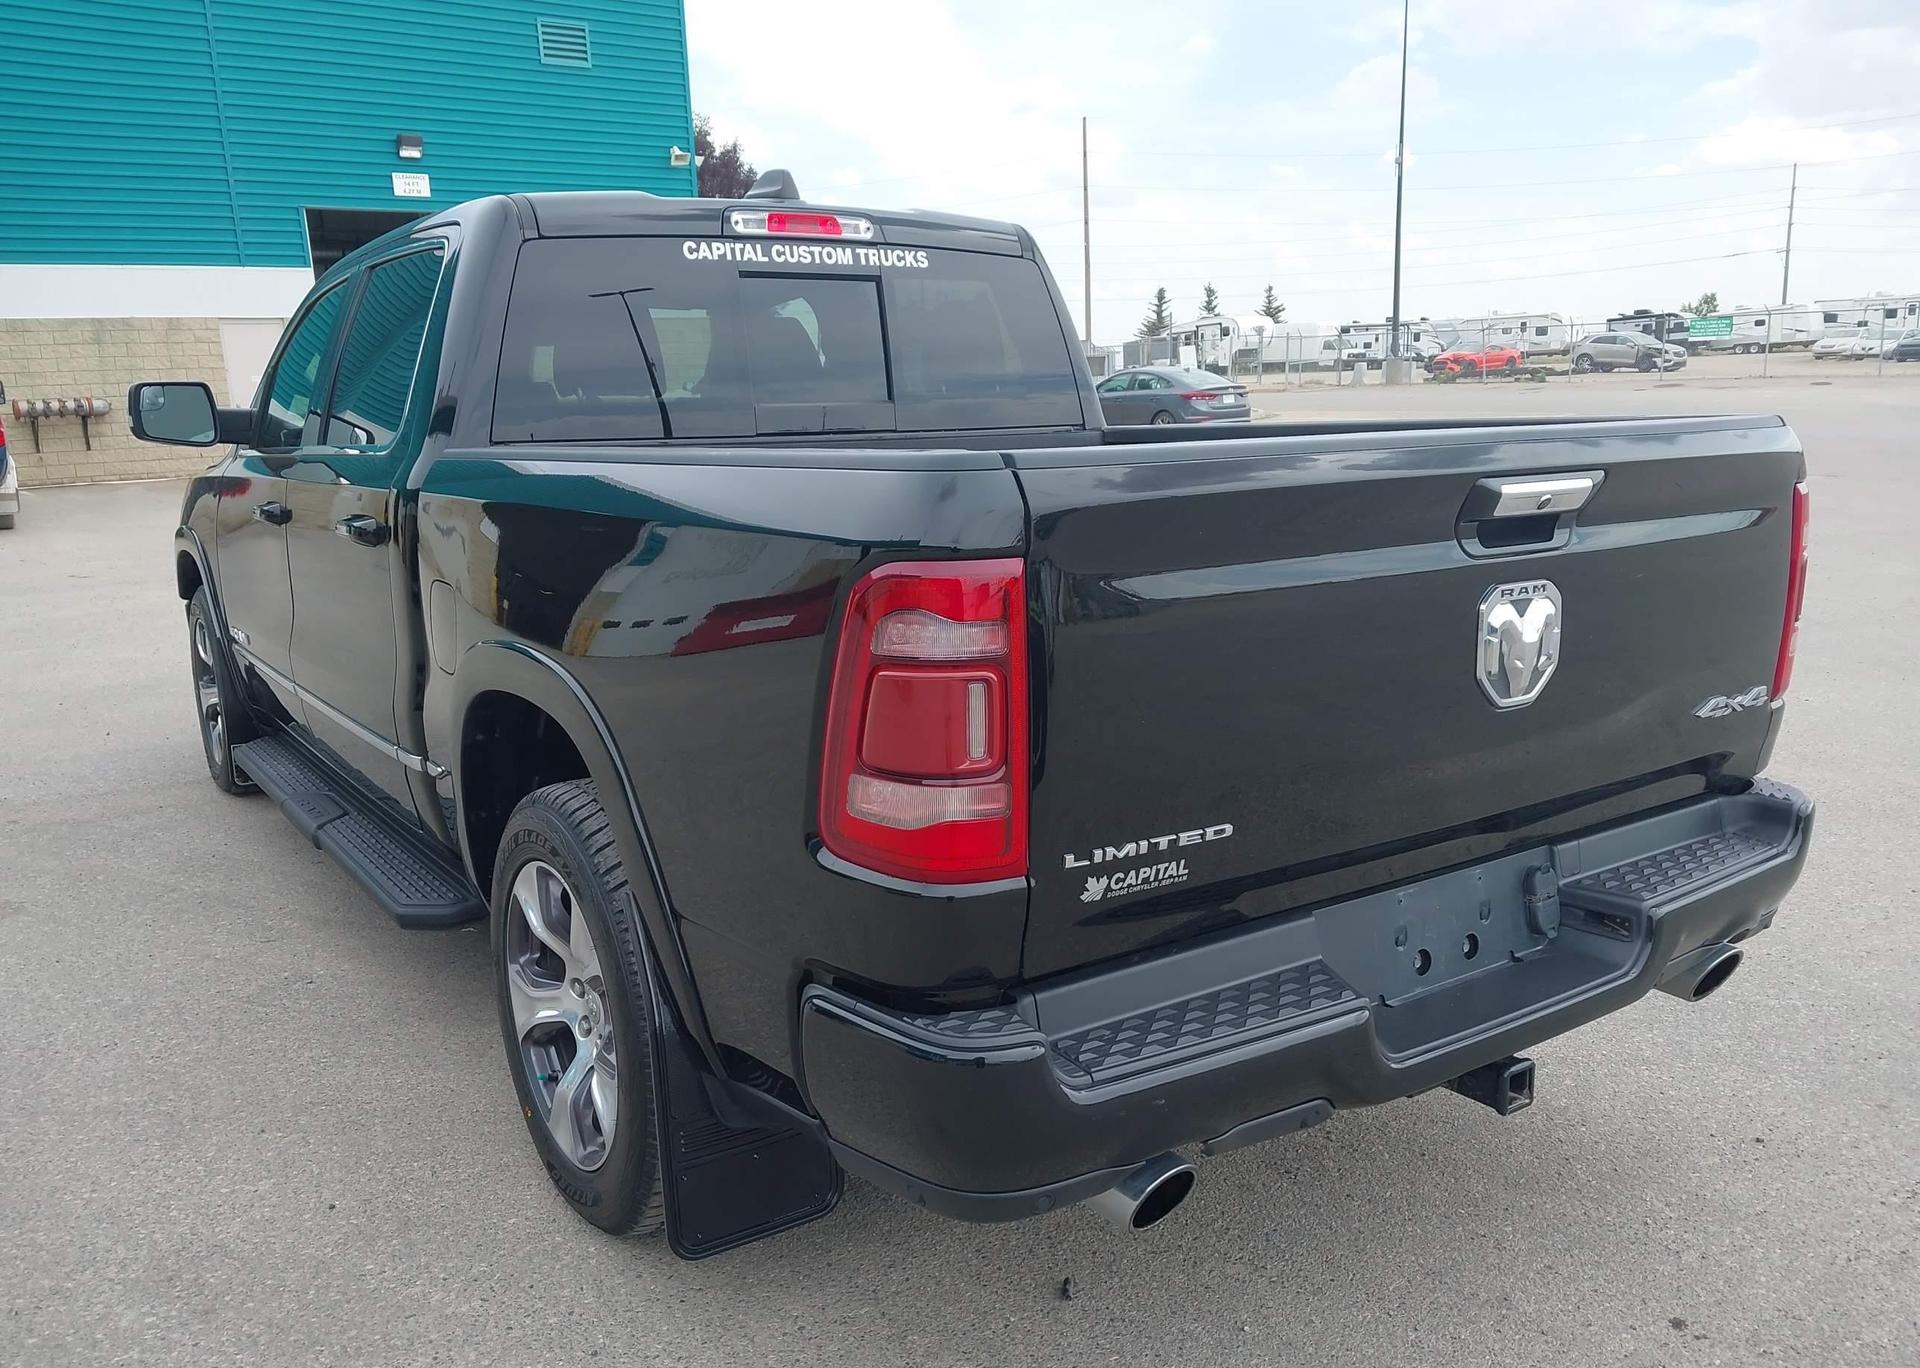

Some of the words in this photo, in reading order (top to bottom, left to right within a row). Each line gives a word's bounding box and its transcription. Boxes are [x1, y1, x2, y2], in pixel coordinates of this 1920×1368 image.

[682, 240, 769, 262] CAPITAL
[771, 244, 853, 265] CUSTOM
[856, 248, 929, 268] TRUCKS
[1500, 583, 1547, 598] RAM
[518, 830, 553, 852] BLADE
[1062, 823, 1234, 869] LIMITED
[1106, 888, 1128, 898] DODGE
[1128, 881, 1159, 893] CHRYSLER
[1159, 878, 1174, 887] JEEP
[1174, 875, 1188, 883] RAM
[1110, 858, 1189, 890] CAPITAL
